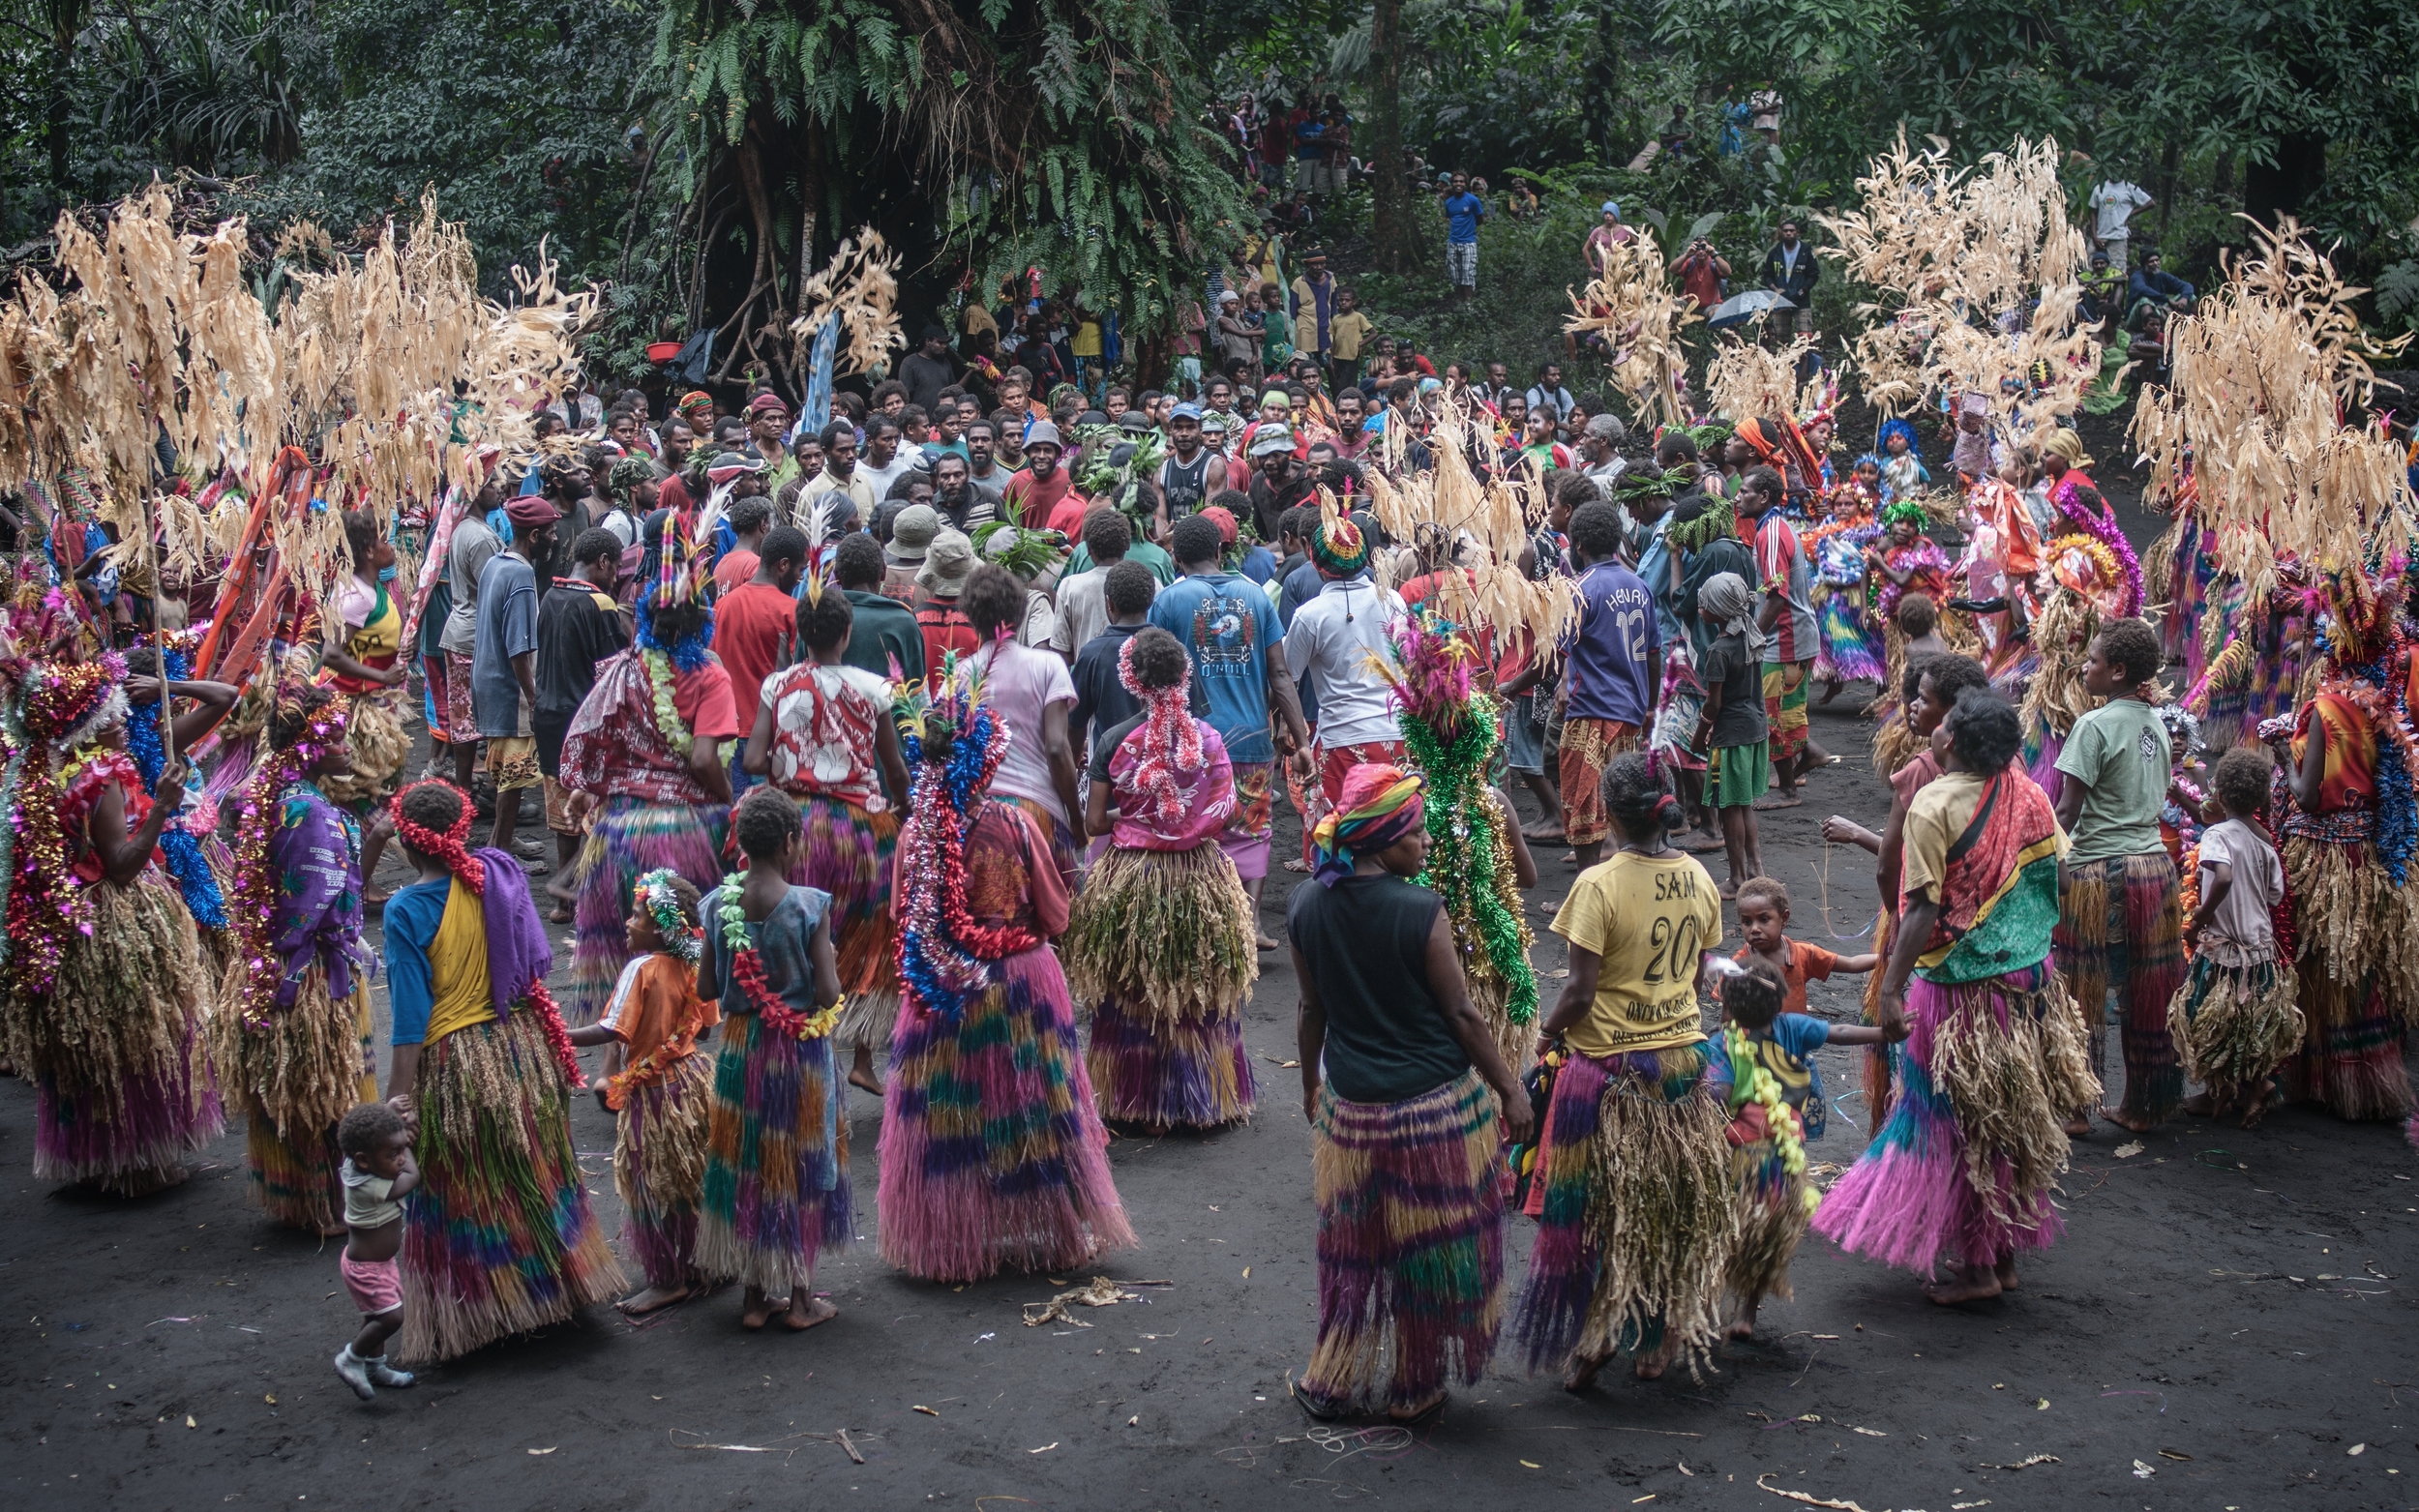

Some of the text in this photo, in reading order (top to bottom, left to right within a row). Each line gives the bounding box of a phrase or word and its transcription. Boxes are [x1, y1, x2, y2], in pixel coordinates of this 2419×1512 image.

[1604, 587, 1649, 612] HENRY
[1615, 608, 1647, 663] 12
[1655, 871, 1697, 901] SAM
[1643, 914, 1698, 986] 20
[1626, 1000, 1657, 1023] ONCE
